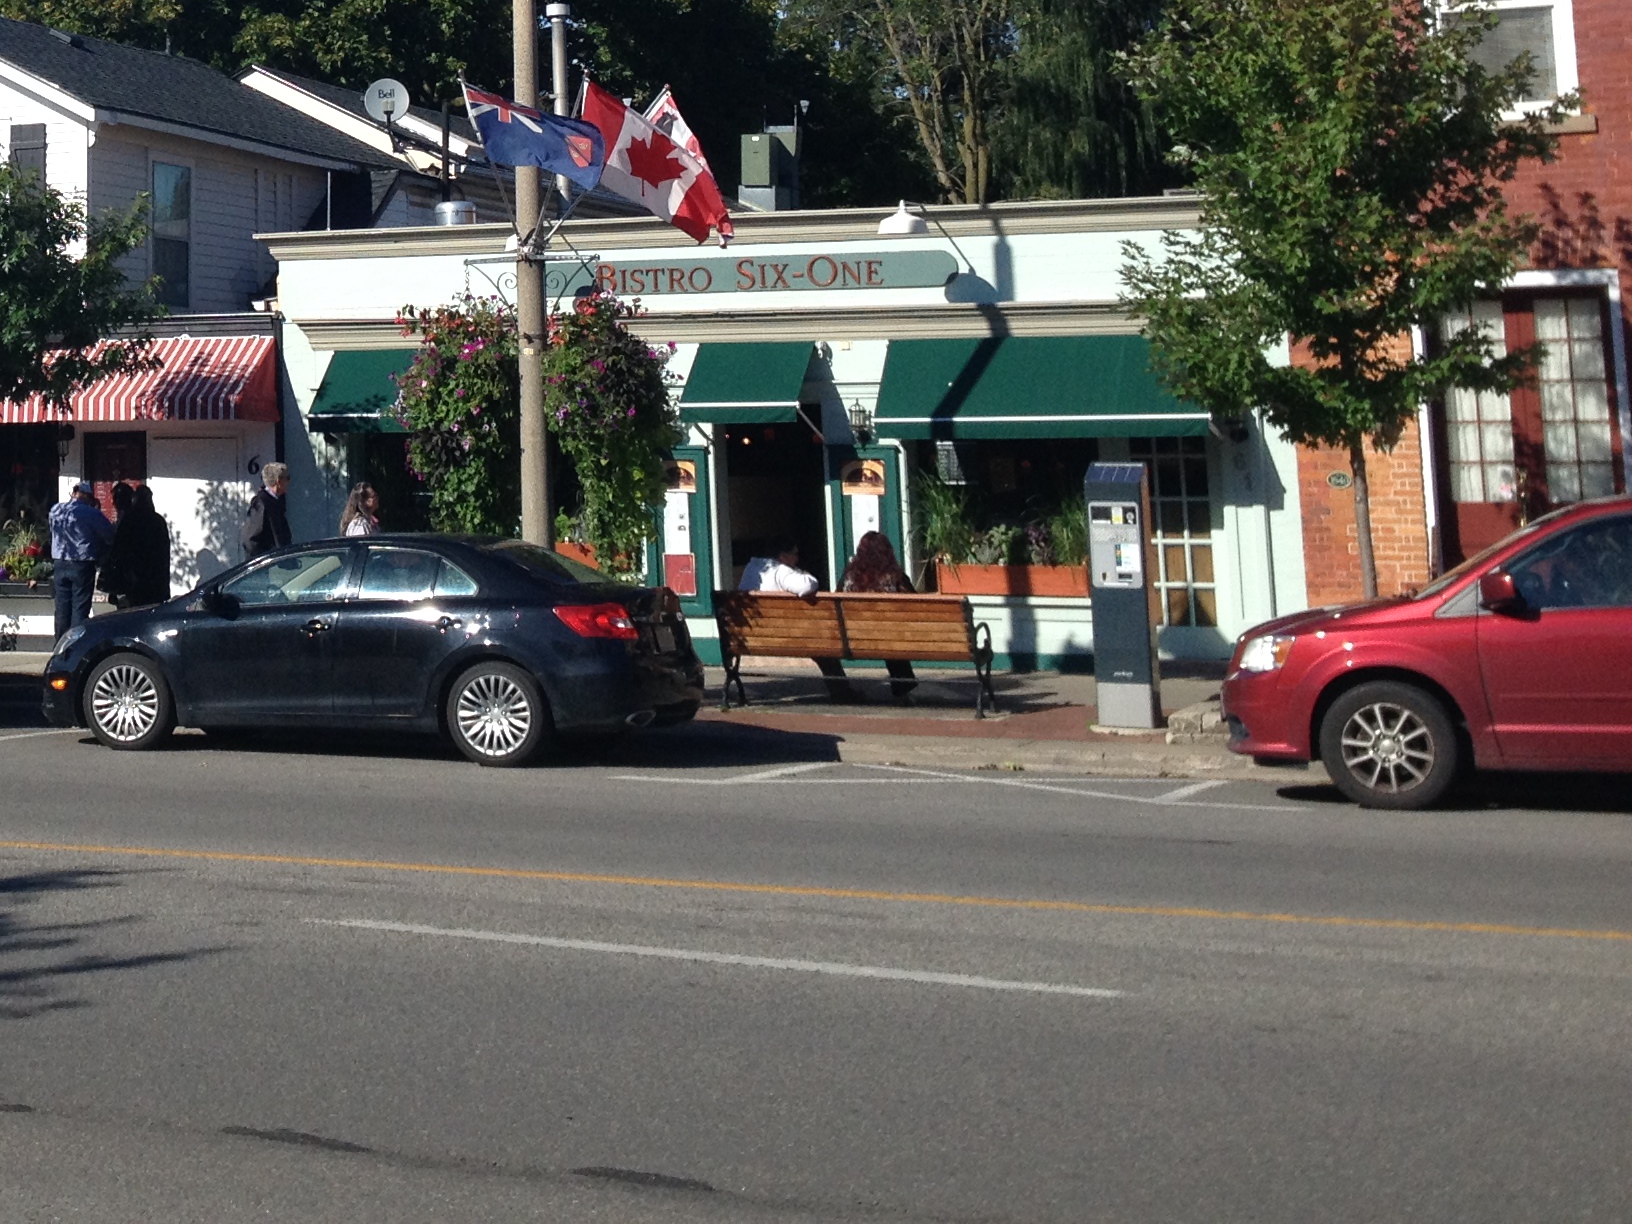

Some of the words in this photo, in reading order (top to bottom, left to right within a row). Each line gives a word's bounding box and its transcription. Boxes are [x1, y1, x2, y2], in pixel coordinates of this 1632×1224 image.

[378, 88, 395, 99] Bell
[596, 263, 713, 294] BISTRO
[735, 254, 885, 291] SIX-ONE
